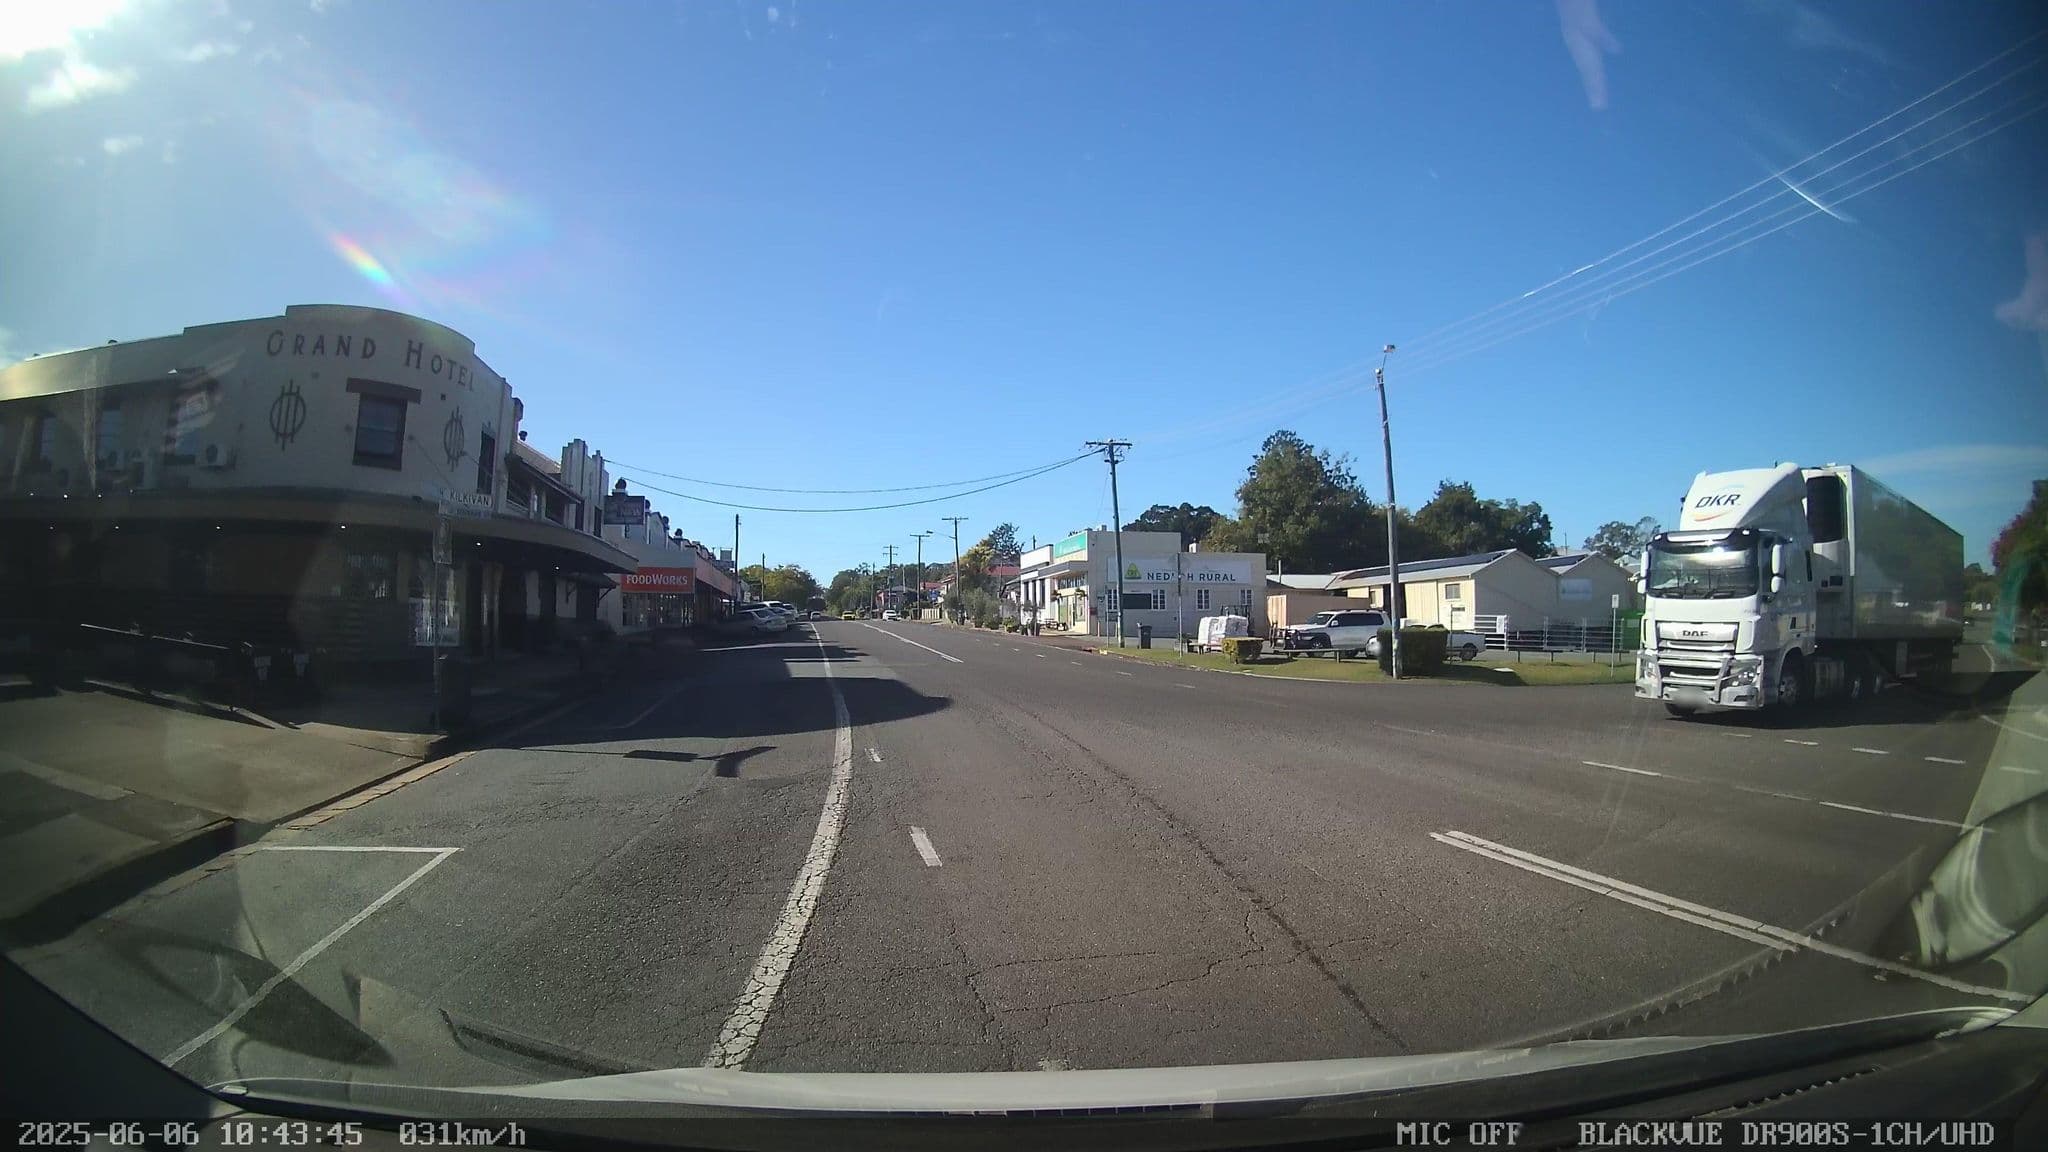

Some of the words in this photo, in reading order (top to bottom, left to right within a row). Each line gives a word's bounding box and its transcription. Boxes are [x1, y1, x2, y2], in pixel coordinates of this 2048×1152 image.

[267, 330, 376, 359] GRAND
[405, 339, 475, 392] HOTEL
[1695, 493, 1741, 508] DKR
[1199, 573, 1236, 582] RURAL
